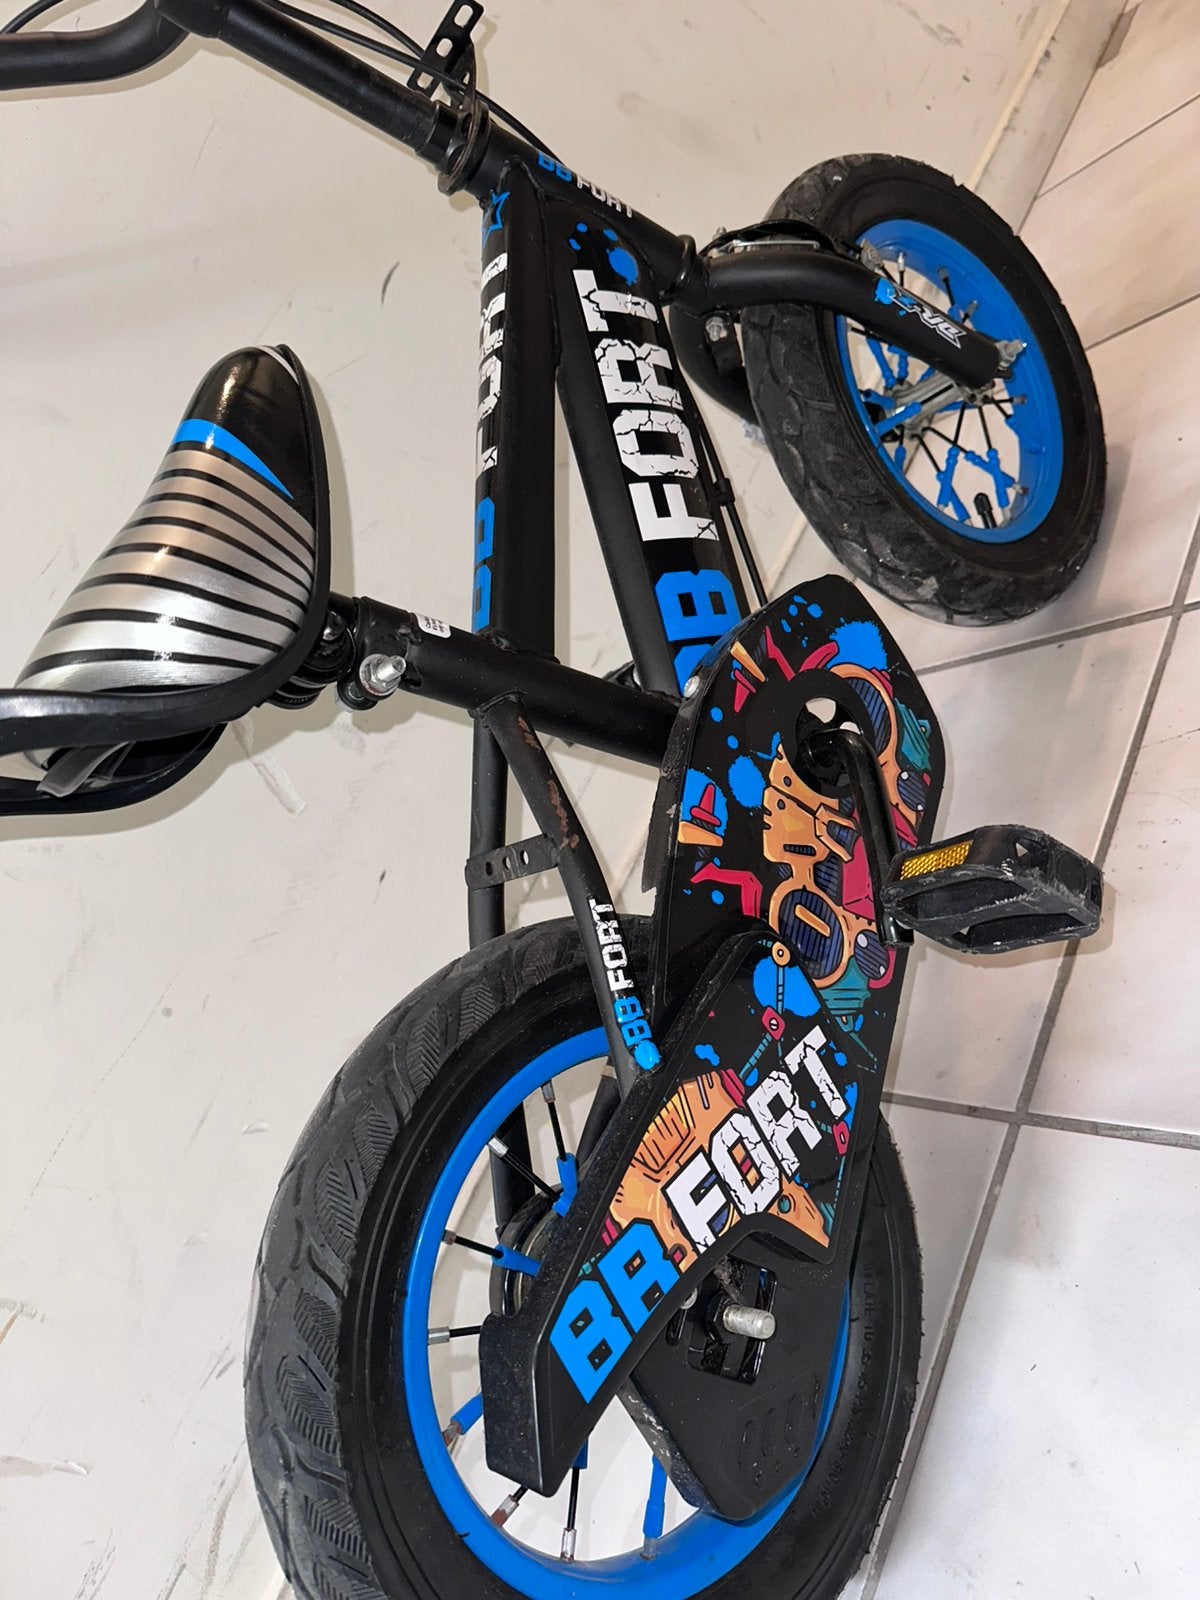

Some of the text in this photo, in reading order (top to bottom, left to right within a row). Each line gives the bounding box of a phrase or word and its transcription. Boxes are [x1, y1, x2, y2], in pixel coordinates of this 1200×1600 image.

[573, 269, 720, 542] FORT
[588, 898, 652, 1047] BB FORT
[665, 1025, 849, 1254] FORT
